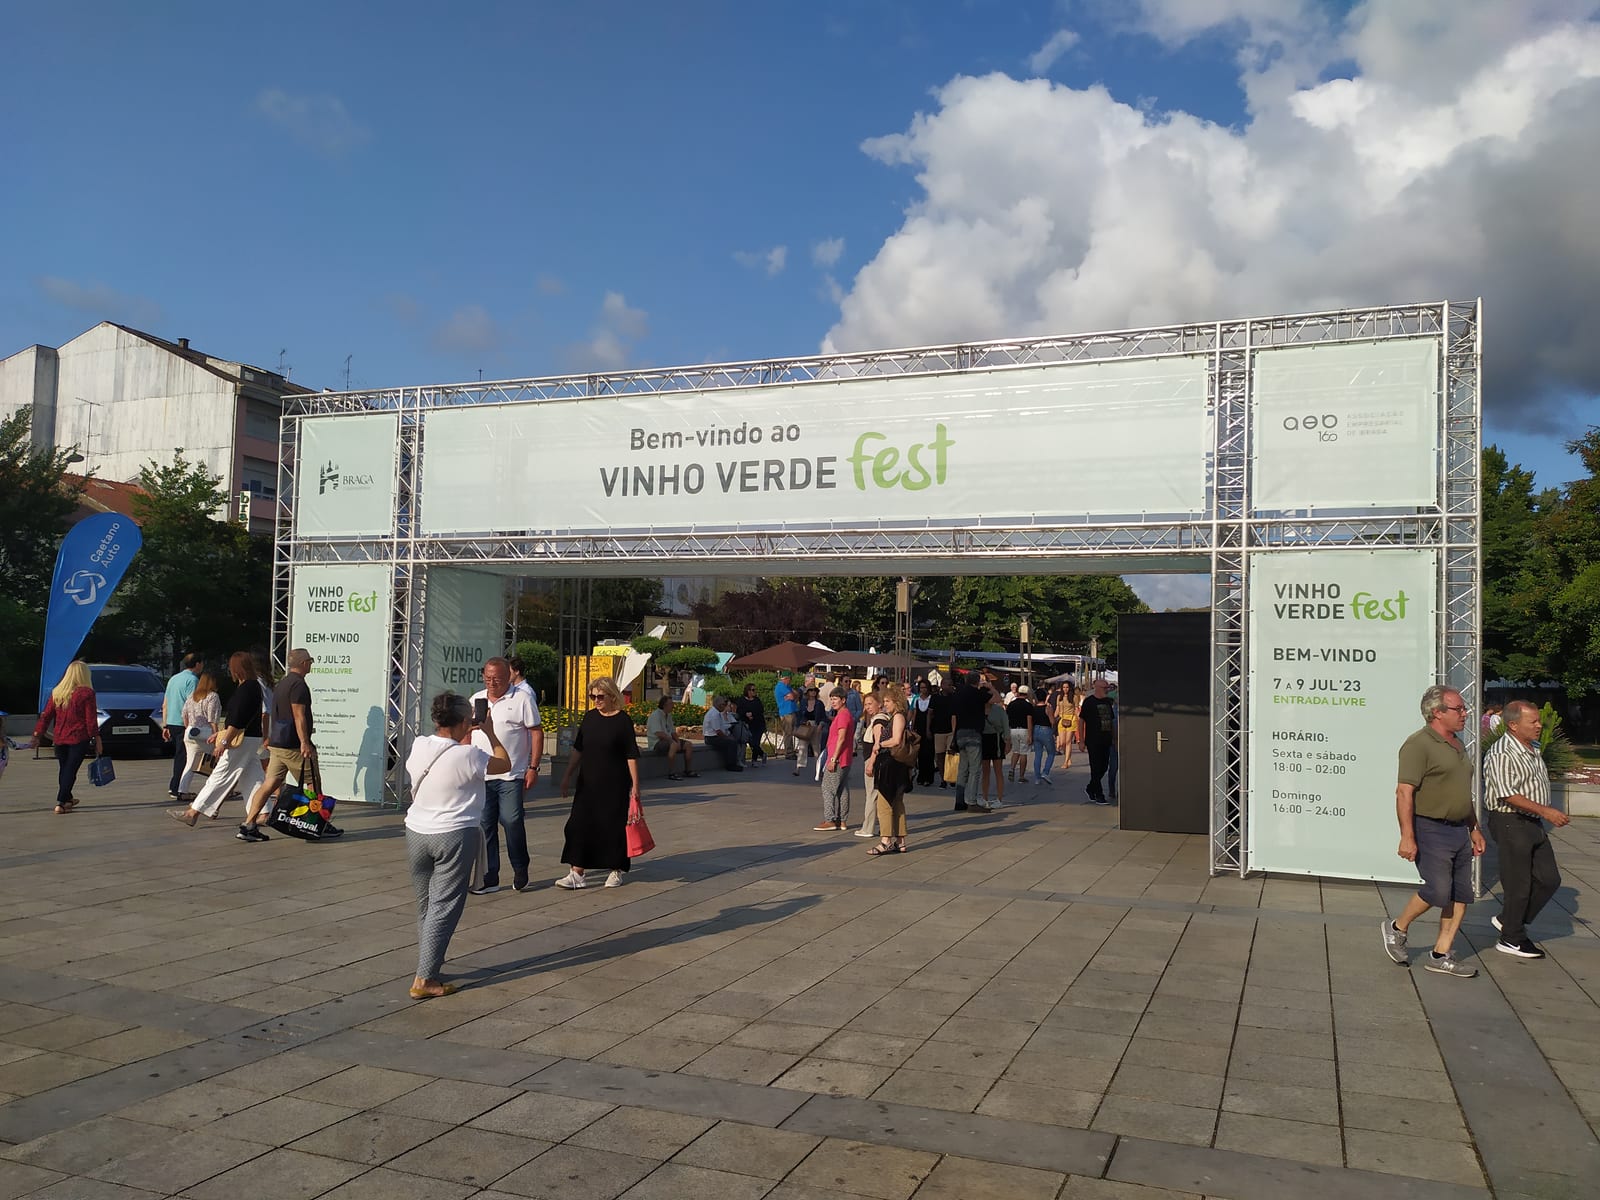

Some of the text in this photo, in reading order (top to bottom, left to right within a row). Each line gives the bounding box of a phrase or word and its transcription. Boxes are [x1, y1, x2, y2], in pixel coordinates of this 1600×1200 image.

[1283, 414, 1338, 431] aeb
[630, 422, 801, 451] Bem-vindo ao
[599, 423, 956, 498] VINHO VERDE fest
[342, 474, 374, 485] BRAGA
[90, 522, 120, 562] Caetano
[100, 543, 120, 568] Auto
[308, 586, 344, 598] VINHO
[1273, 583, 1341, 600] VINHO
[307, 590, 378, 613] VERDE fest
[1273, 590, 1410, 622] VERDE fest
[305, 633, 360, 643] BEM-VINDO
[317, 655, 322, 663] 9
[323, 655, 351, 664] JUL'23
[442, 646, 483, 663] VINHO
[1273, 648, 1377, 663] BEM-VINDO
[334, 667, 353, 675] LIVRE
[442, 667, 484, 683] VERDE
[1273, 678, 1281, 690] 7
[1296, 679, 1305, 690] 9
[1309, 679, 1362, 692] JUL'23
[1273, 695, 1366, 707] ENTRADA LIVRE
[1272, 730, 1329, 743] HORÁRIO:
[1272, 748, 1357, 761] Sexta e sábado
[1272, 763, 1303, 773] 18:00
[1315, 764, 1346, 775] 02:00
[1272, 790, 1322, 802] Domingo
[1272, 804, 1302, 814] 16:00
[1315, 805, 1346, 817] 24:00
